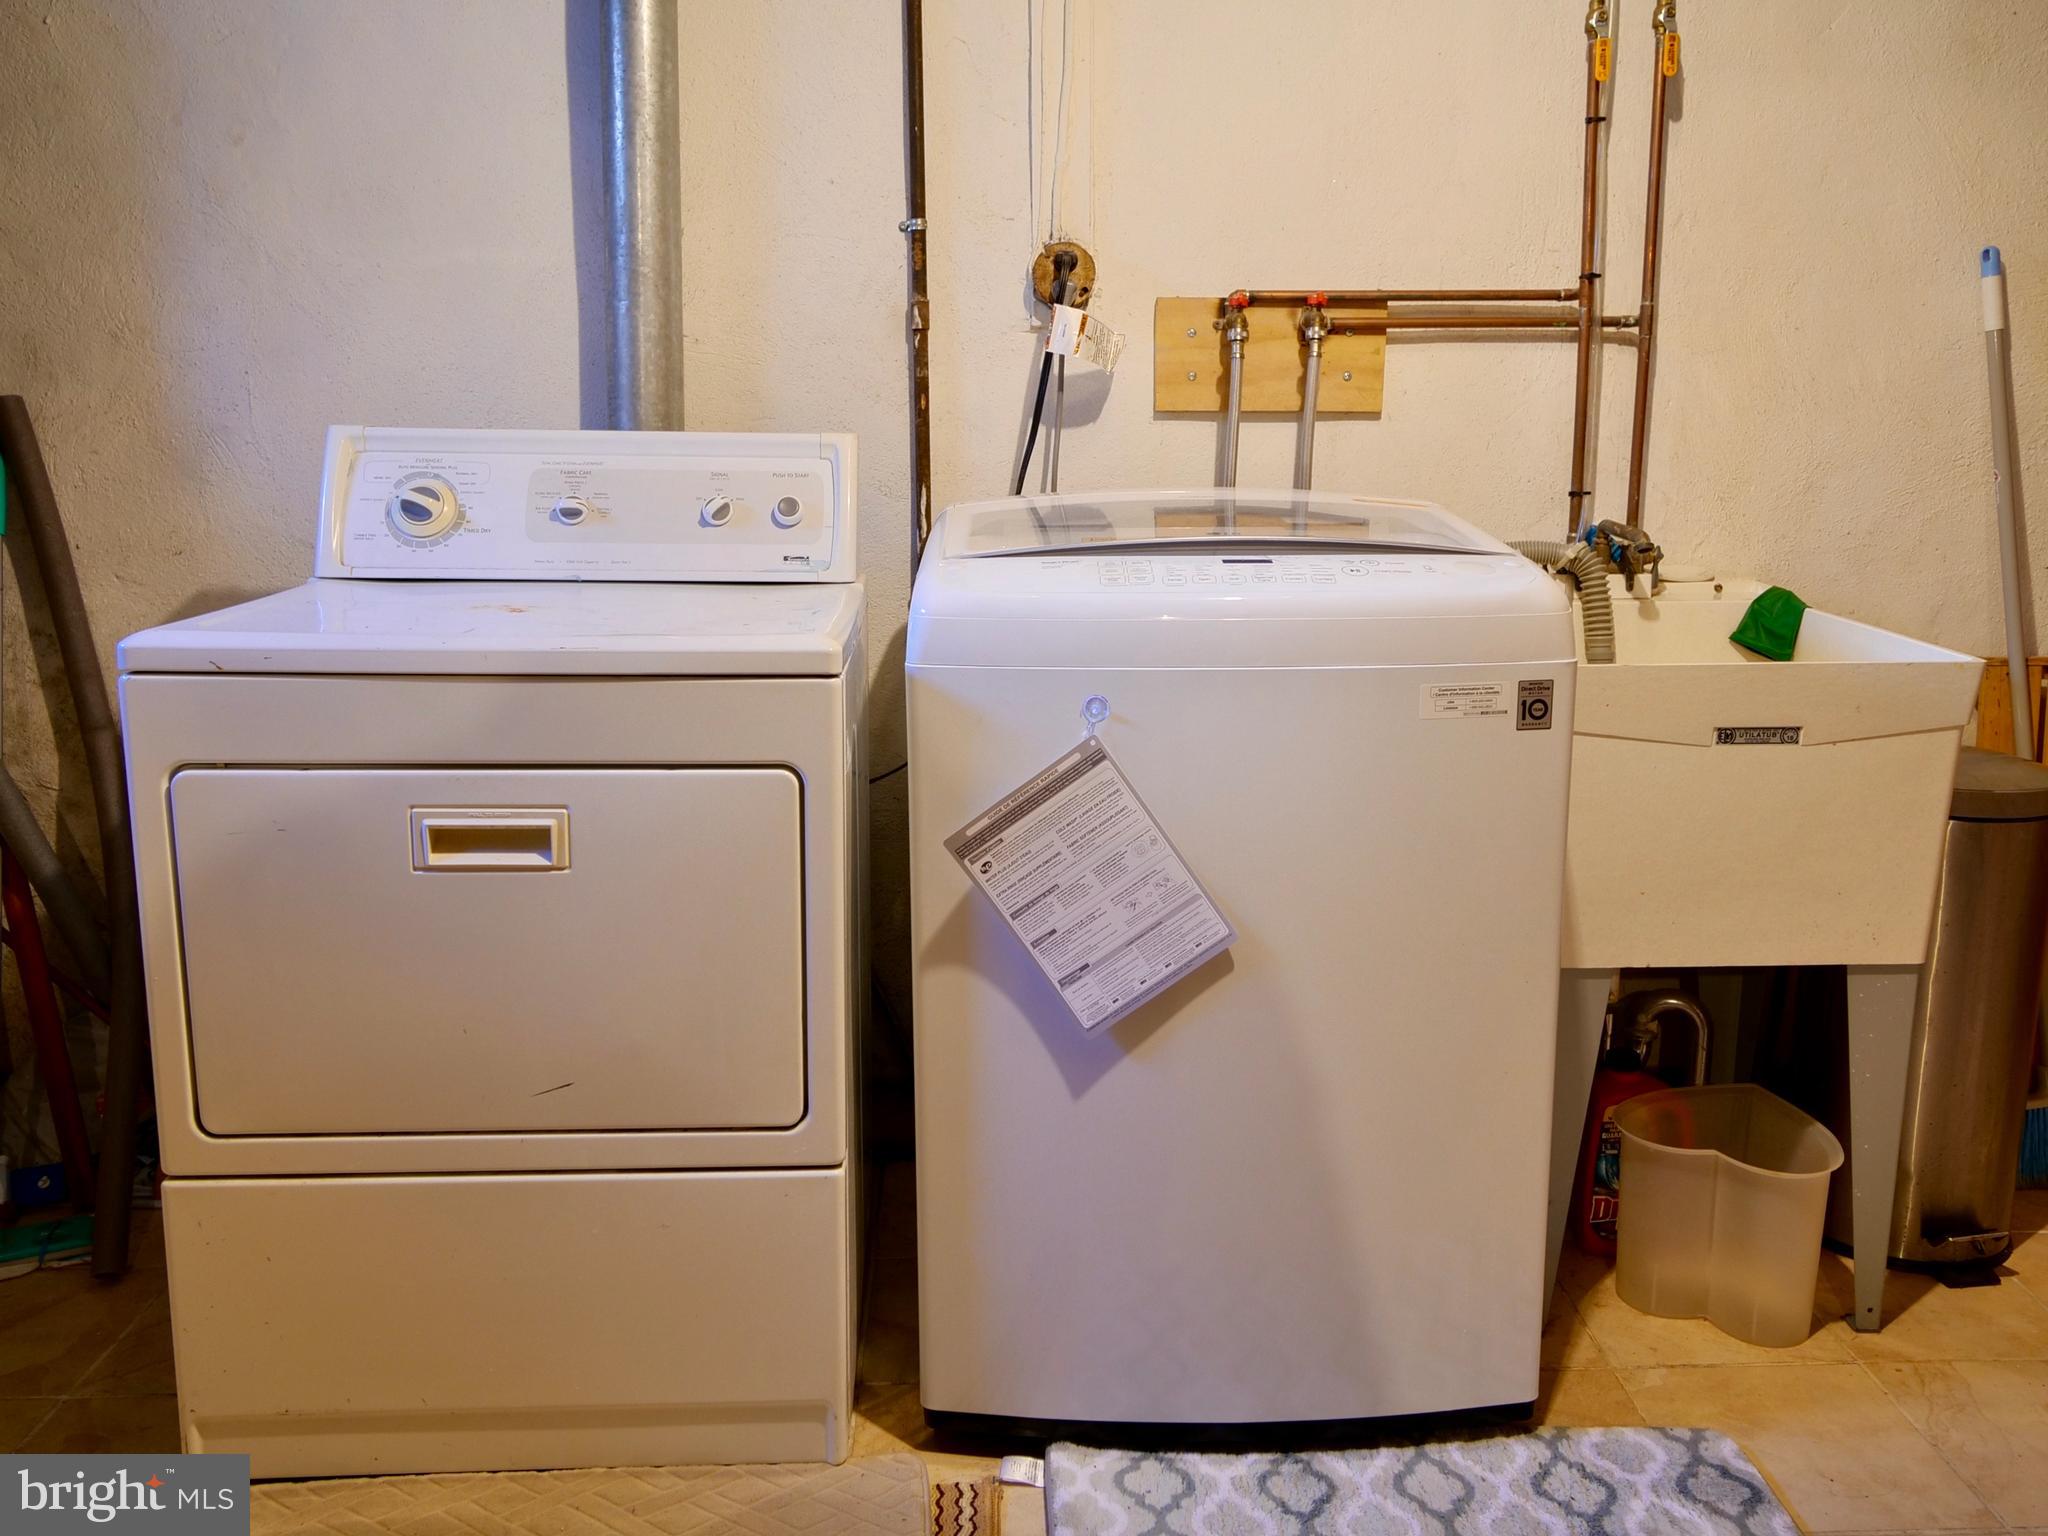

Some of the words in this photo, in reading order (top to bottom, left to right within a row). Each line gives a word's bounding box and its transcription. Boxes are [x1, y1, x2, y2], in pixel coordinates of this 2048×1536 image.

[1521, 698, 1549, 721] 10
[1739, 730, 1778, 738] UTILATUB
[987, 807, 1003, 821] GUIDE
[1002, 801, 1011, 810] DE
[1040, 768, 1059, 784] RAPIDE
